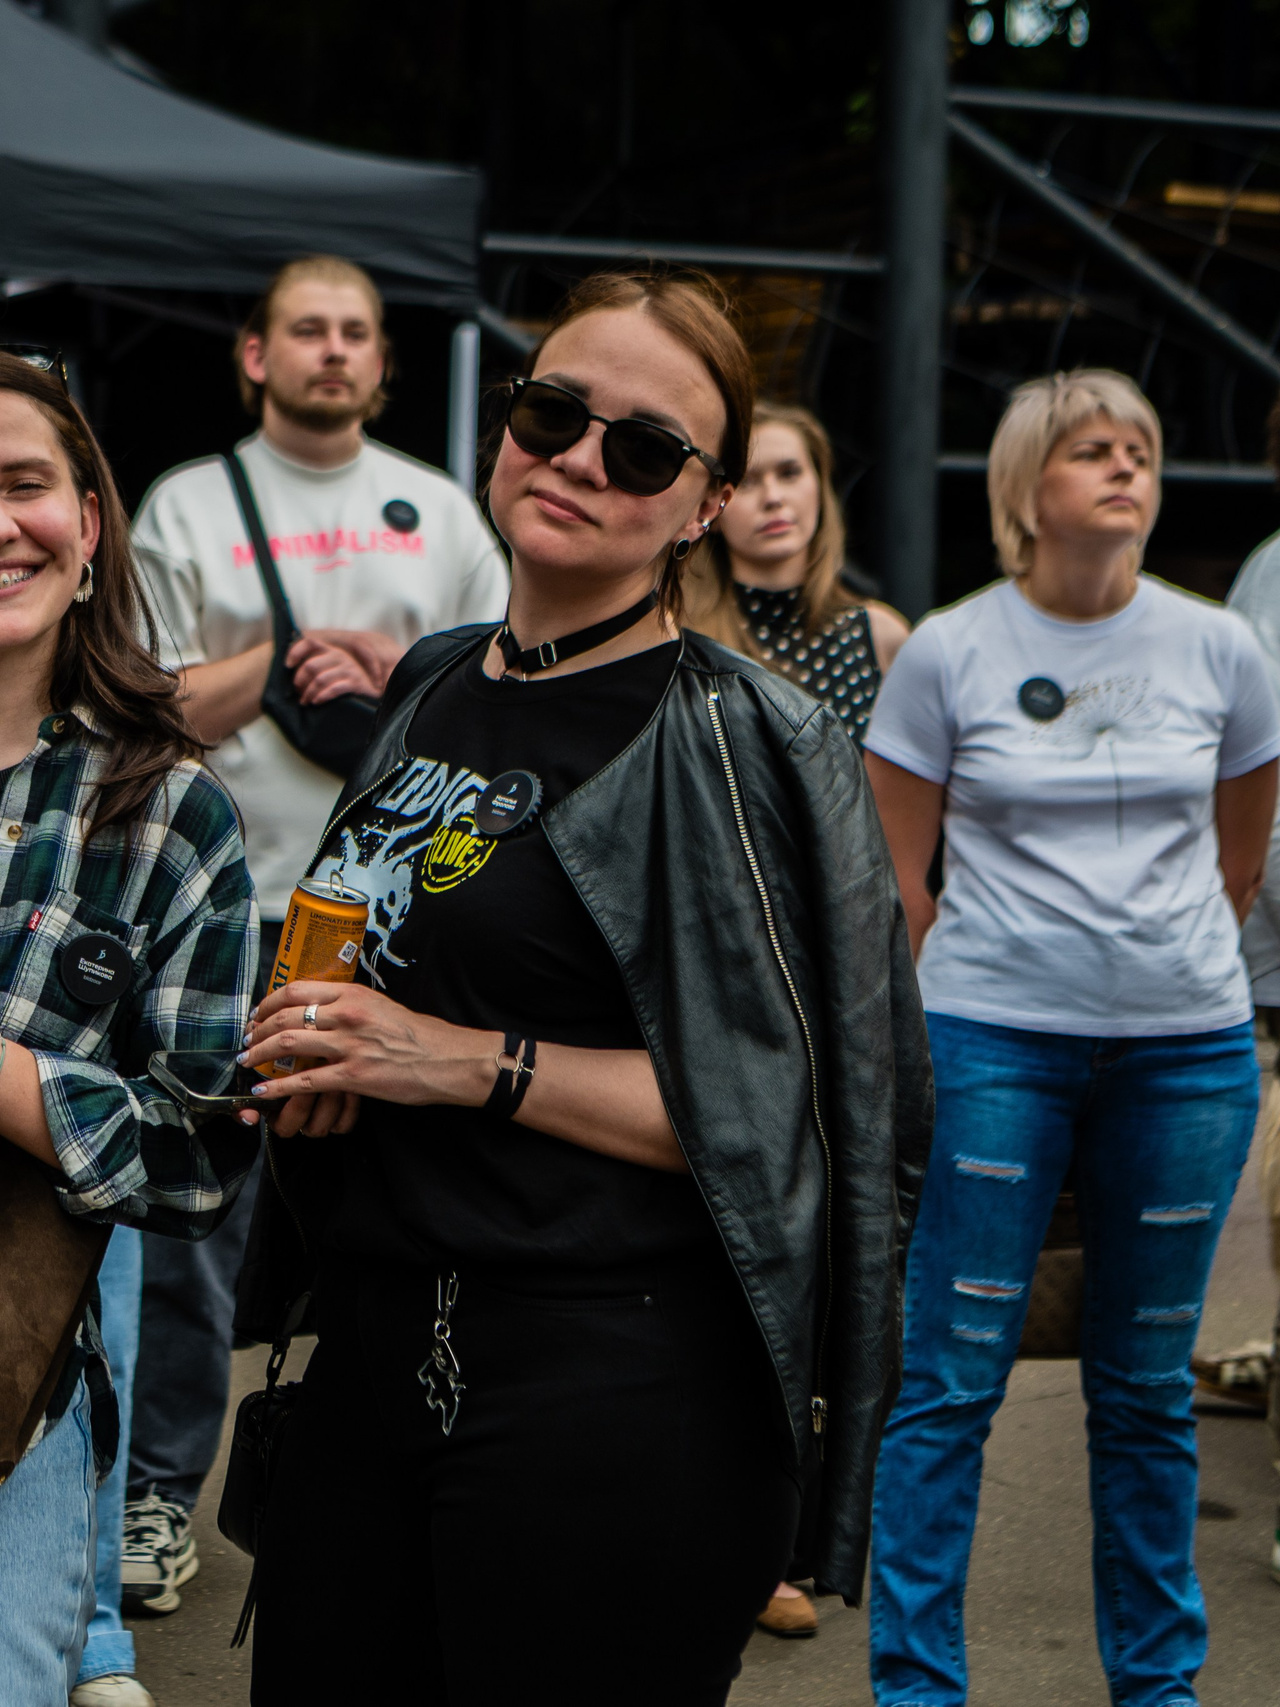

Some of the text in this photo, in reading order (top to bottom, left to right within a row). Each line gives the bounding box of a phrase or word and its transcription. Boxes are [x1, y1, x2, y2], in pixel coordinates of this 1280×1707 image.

[231, 527, 425, 569] MNIMALISM
[309, 912, 342, 925] LIMONATI
[272, 960, 290, 992] ATI
[284, 905, 300, 953] BORJOMI
[79, 957, 116, 976] Екатерина
